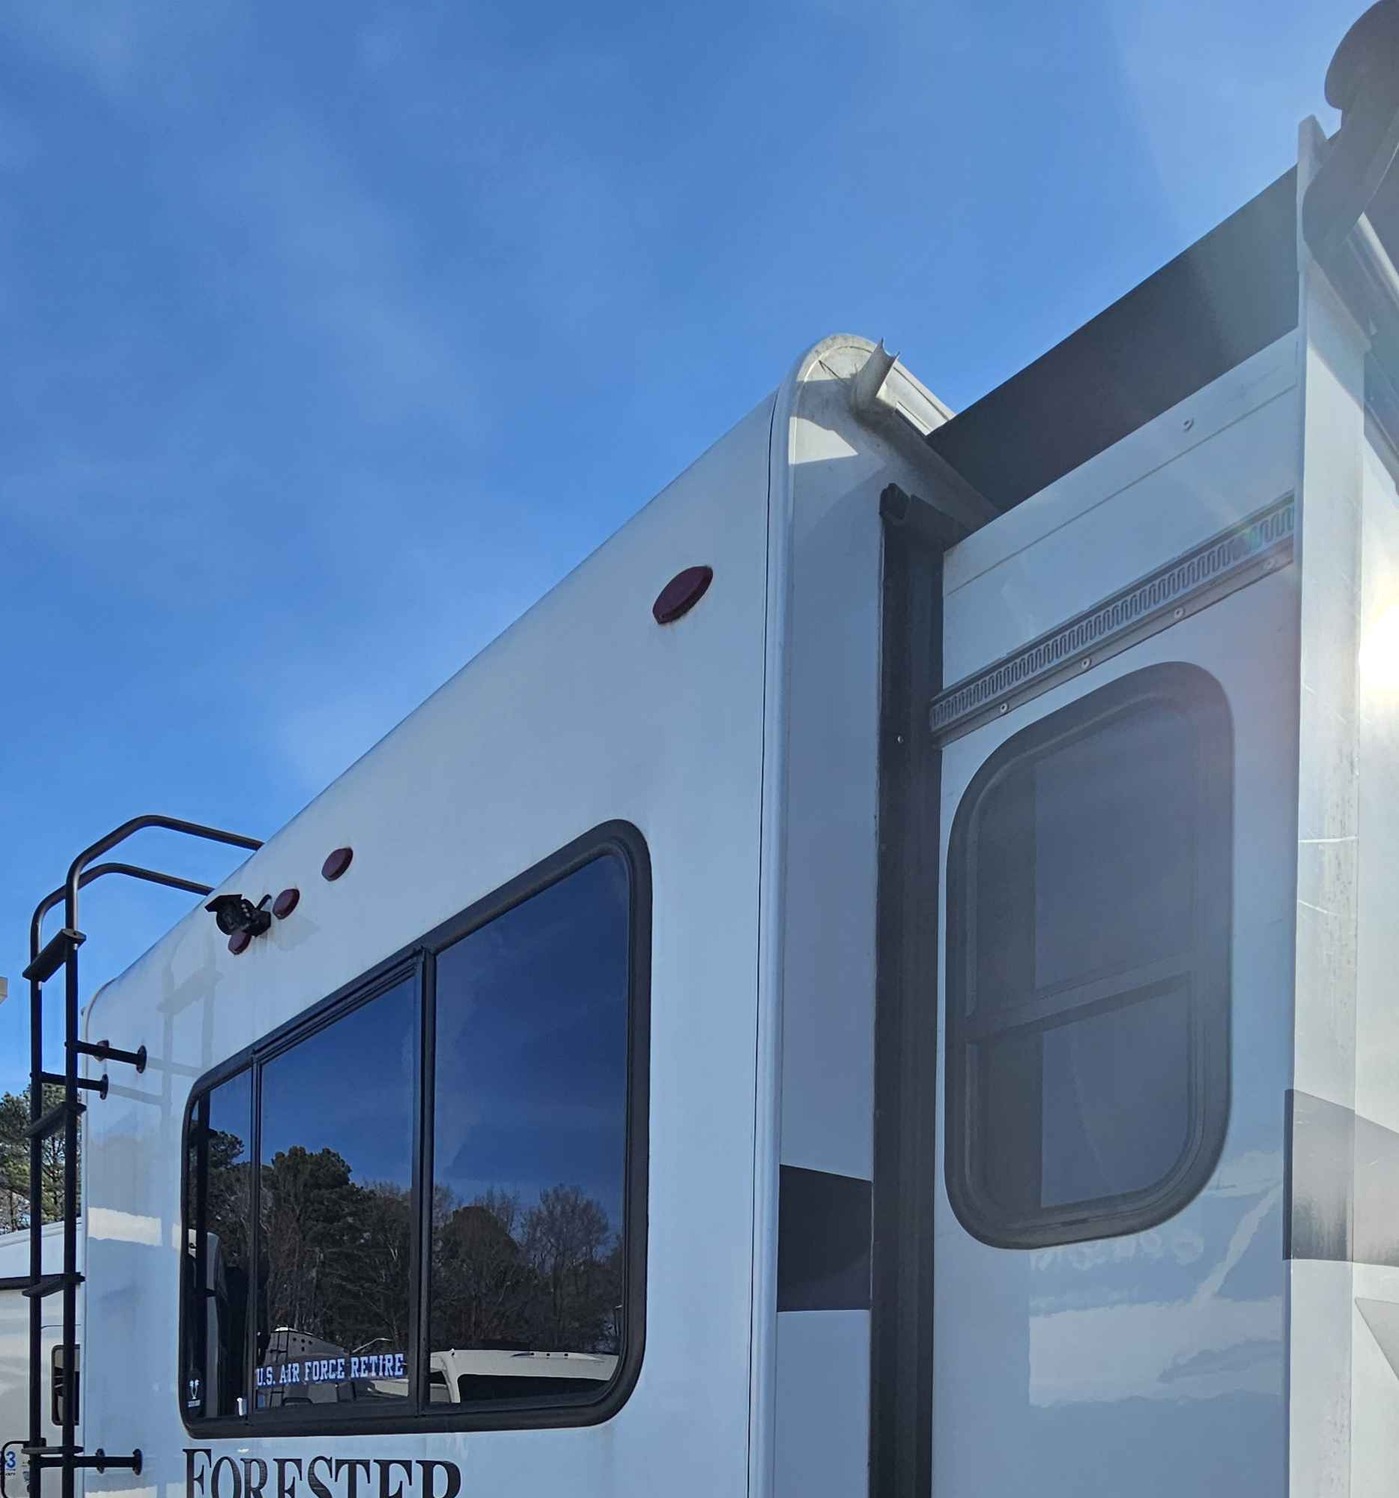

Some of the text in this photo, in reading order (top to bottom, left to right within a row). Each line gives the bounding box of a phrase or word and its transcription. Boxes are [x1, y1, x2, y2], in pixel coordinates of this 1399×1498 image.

[255, 1353, 405, 1386] U.S. AIR FORCE RETIRE
